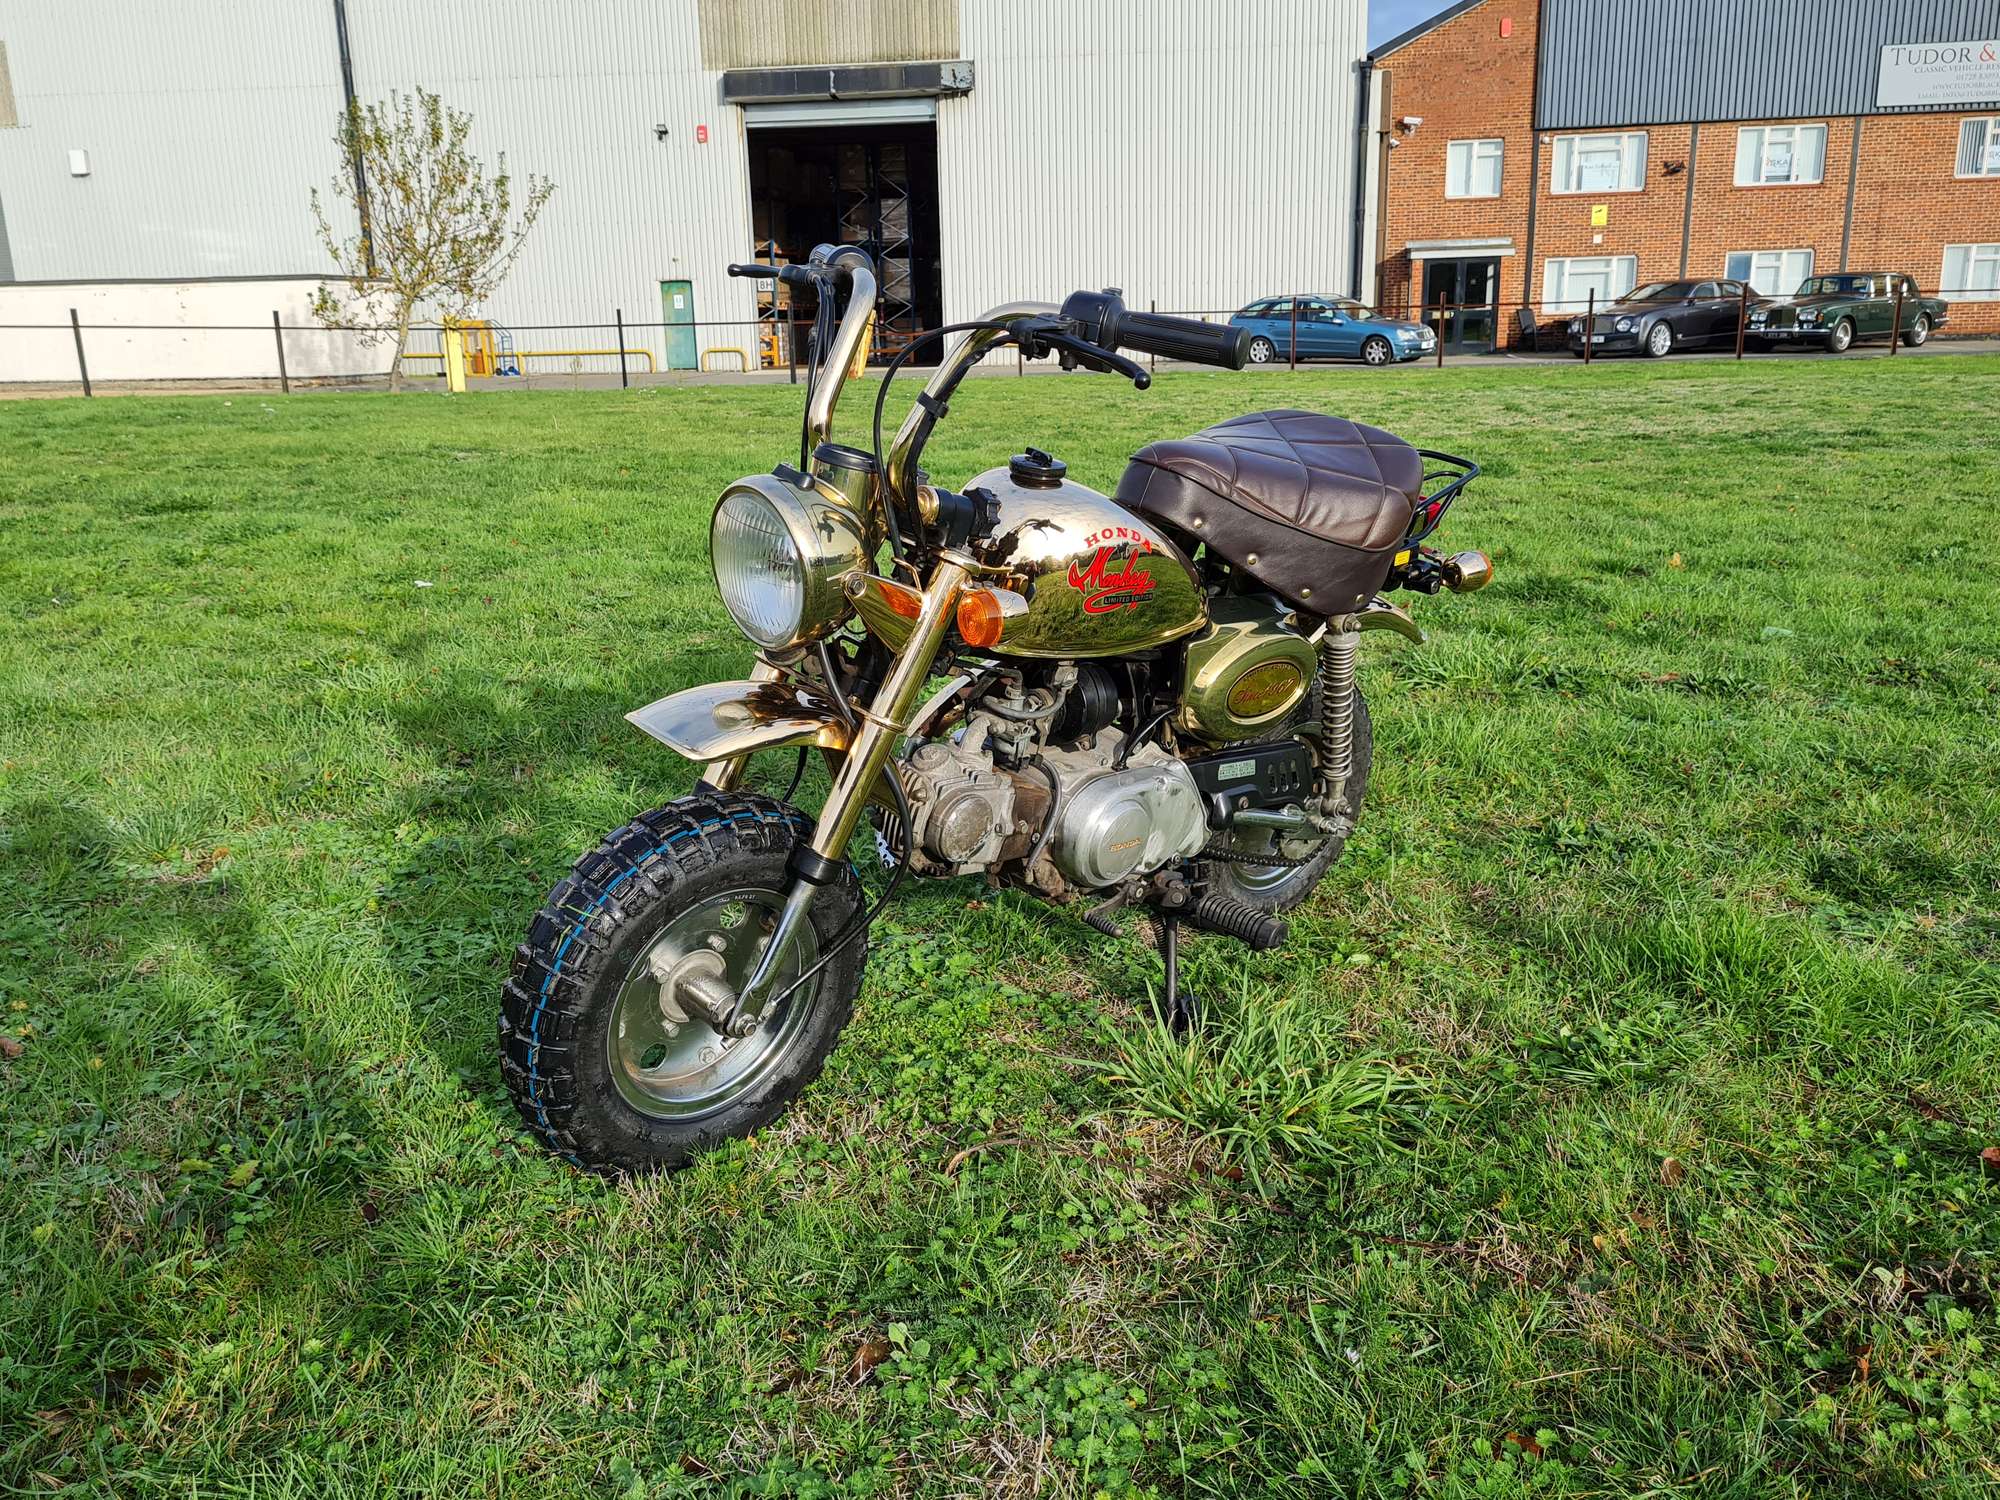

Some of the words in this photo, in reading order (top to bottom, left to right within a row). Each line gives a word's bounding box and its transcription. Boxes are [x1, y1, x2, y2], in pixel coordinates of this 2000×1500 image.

[1890, 47, 1972, 66] TUDOR
[1979, 43, 1997, 62] &
[1914, 65, 1947, 73] CLASSIC
[1084, 527, 1152, 553] HONDA
[1067, 546, 1157, 613] Monkey
[1104, 595, 1130, 604] LIMITED
